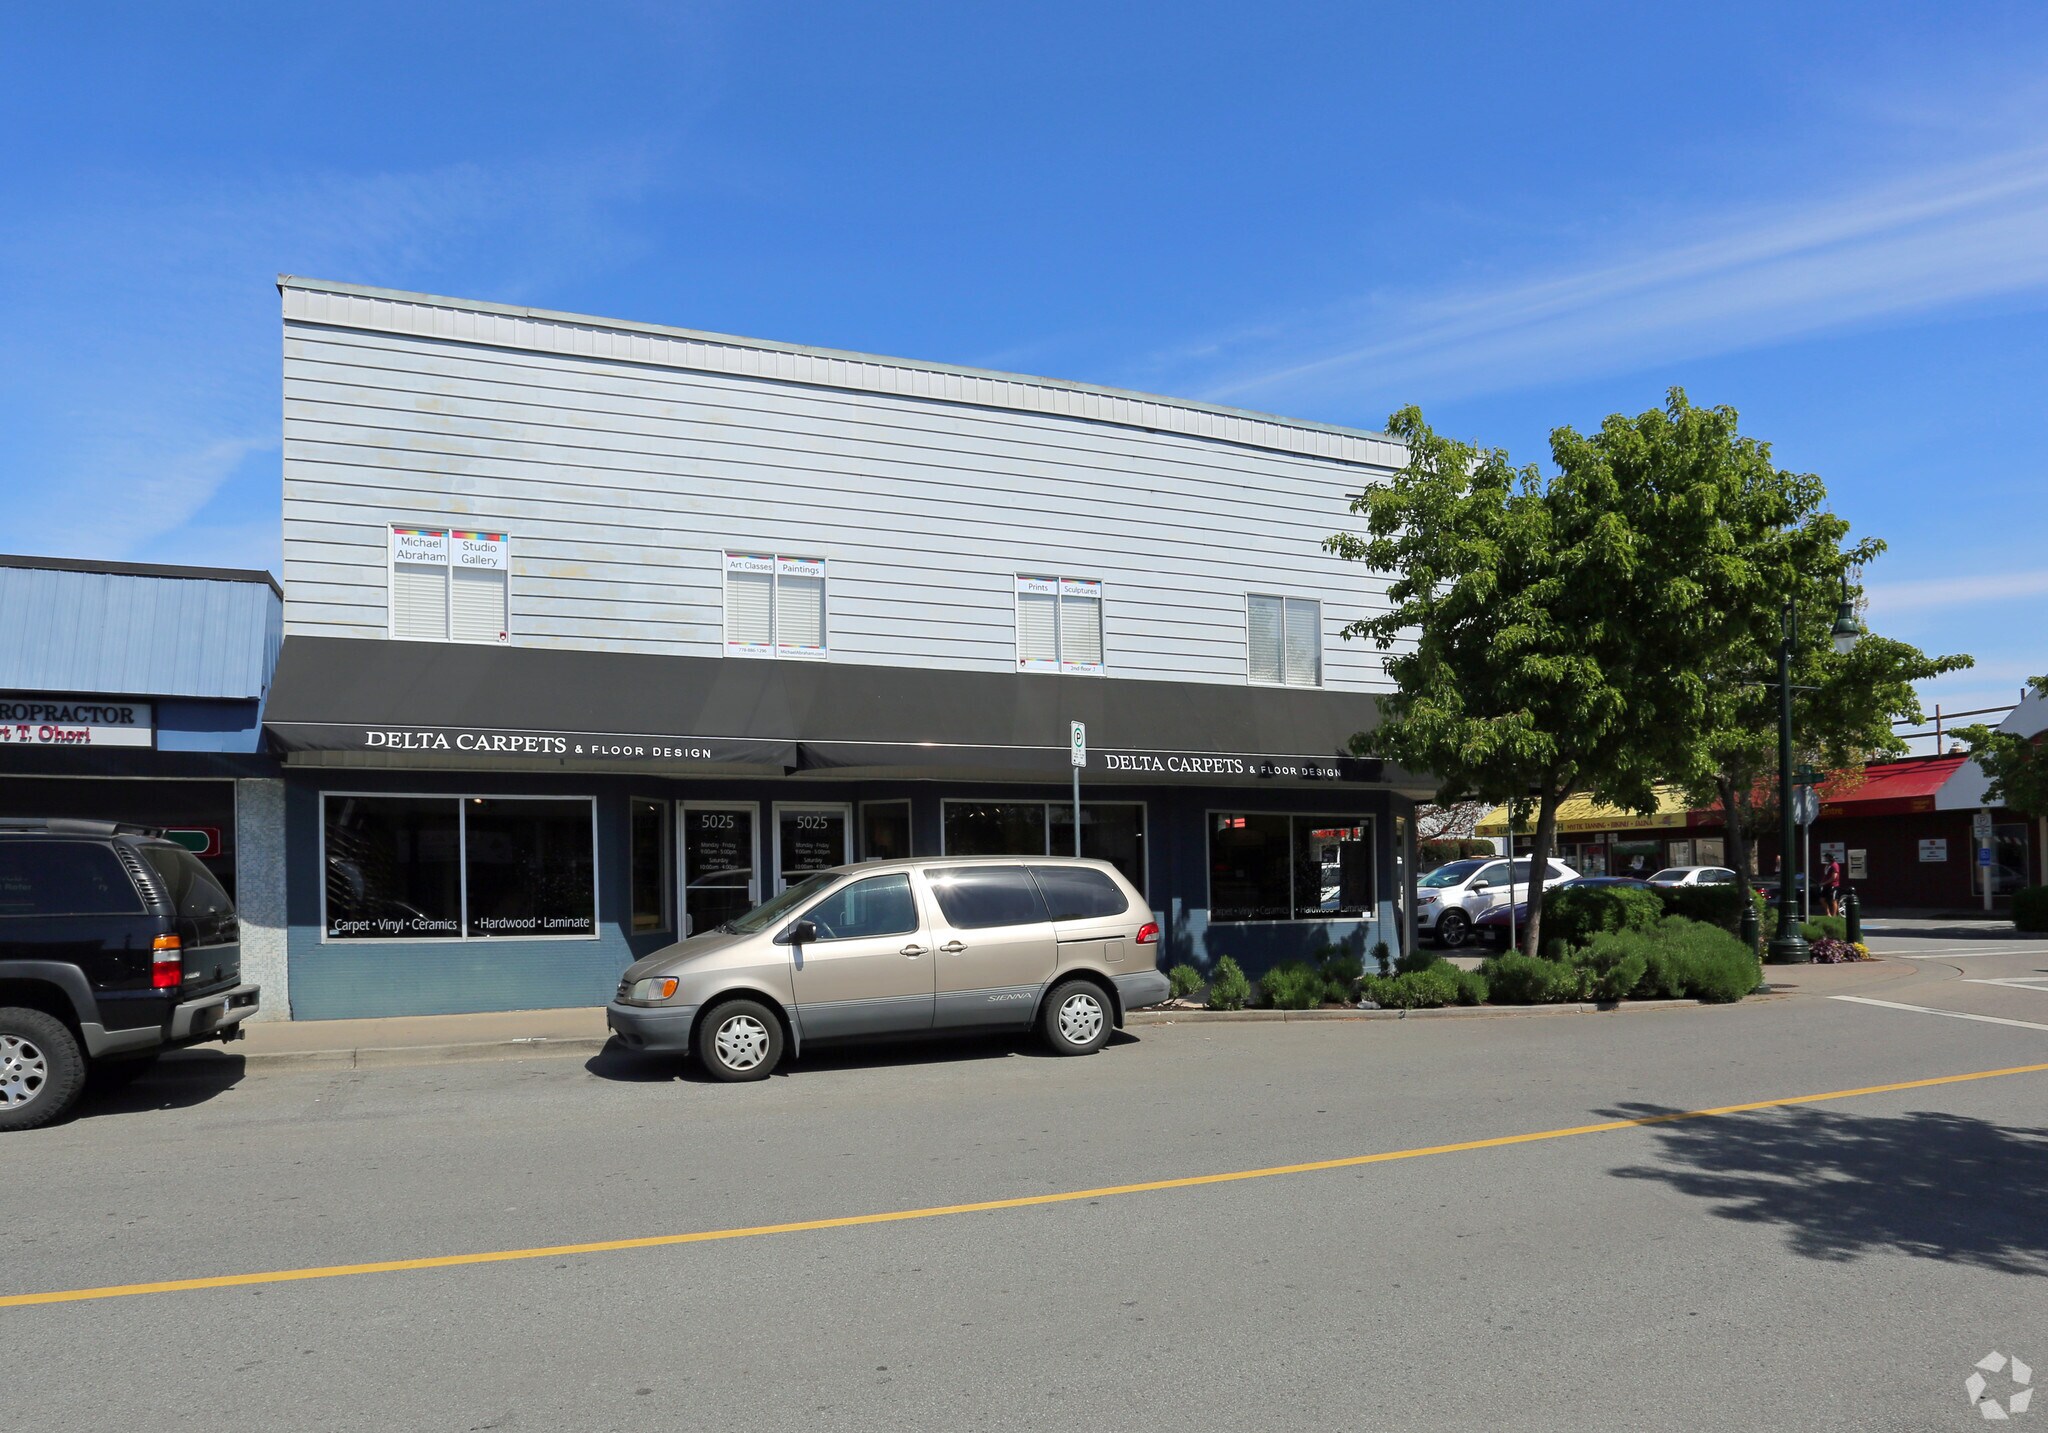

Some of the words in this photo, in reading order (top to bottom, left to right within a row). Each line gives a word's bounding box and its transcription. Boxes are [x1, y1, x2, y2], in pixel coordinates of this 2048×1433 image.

[401, 537, 441, 548] Michael
[462, 541, 497, 553] Studio
[396, 550, 446, 562] Abraham
[461, 554, 498, 567] Gallery
[730, 561, 742, 569] Art
[744, 562, 773, 571] Classes
[782, 563, 820, 576] Paintings
[1028, 582, 1049, 591] Prints
[1064, 585, 1098, 595] Sculptures
[38, 724, 91, 744] Ohori
[364, 731, 451, 749] DELTA
[456, 734, 567, 754] CARPETS
[574, 744, 583, 754] &
[591, 745, 644, 756] FLOOR
[652, 747, 711, 758] DESIGN
[1104, 754, 1165, 771] DELTA
[1167, 756, 1244, 774] CARPETS
[1249, 765, 1256, 774] &
[1260, 766, 1297, 775] FLOOR
[1301, 767, 1341, 777] DESIGN
[701, 814, 734, 829] 5025
[797, 815, 828, 829] 5025
[334, 918, 370, 934] Carpet
[378, 918, 404, 934] Vinyl
[411, 918, 458, 930] Ceramics
[480, 916, 536, 929] Hardwood
[543, 916, 590, 928] Laminate
[987, 992, 1032, 1002] SIENNA
